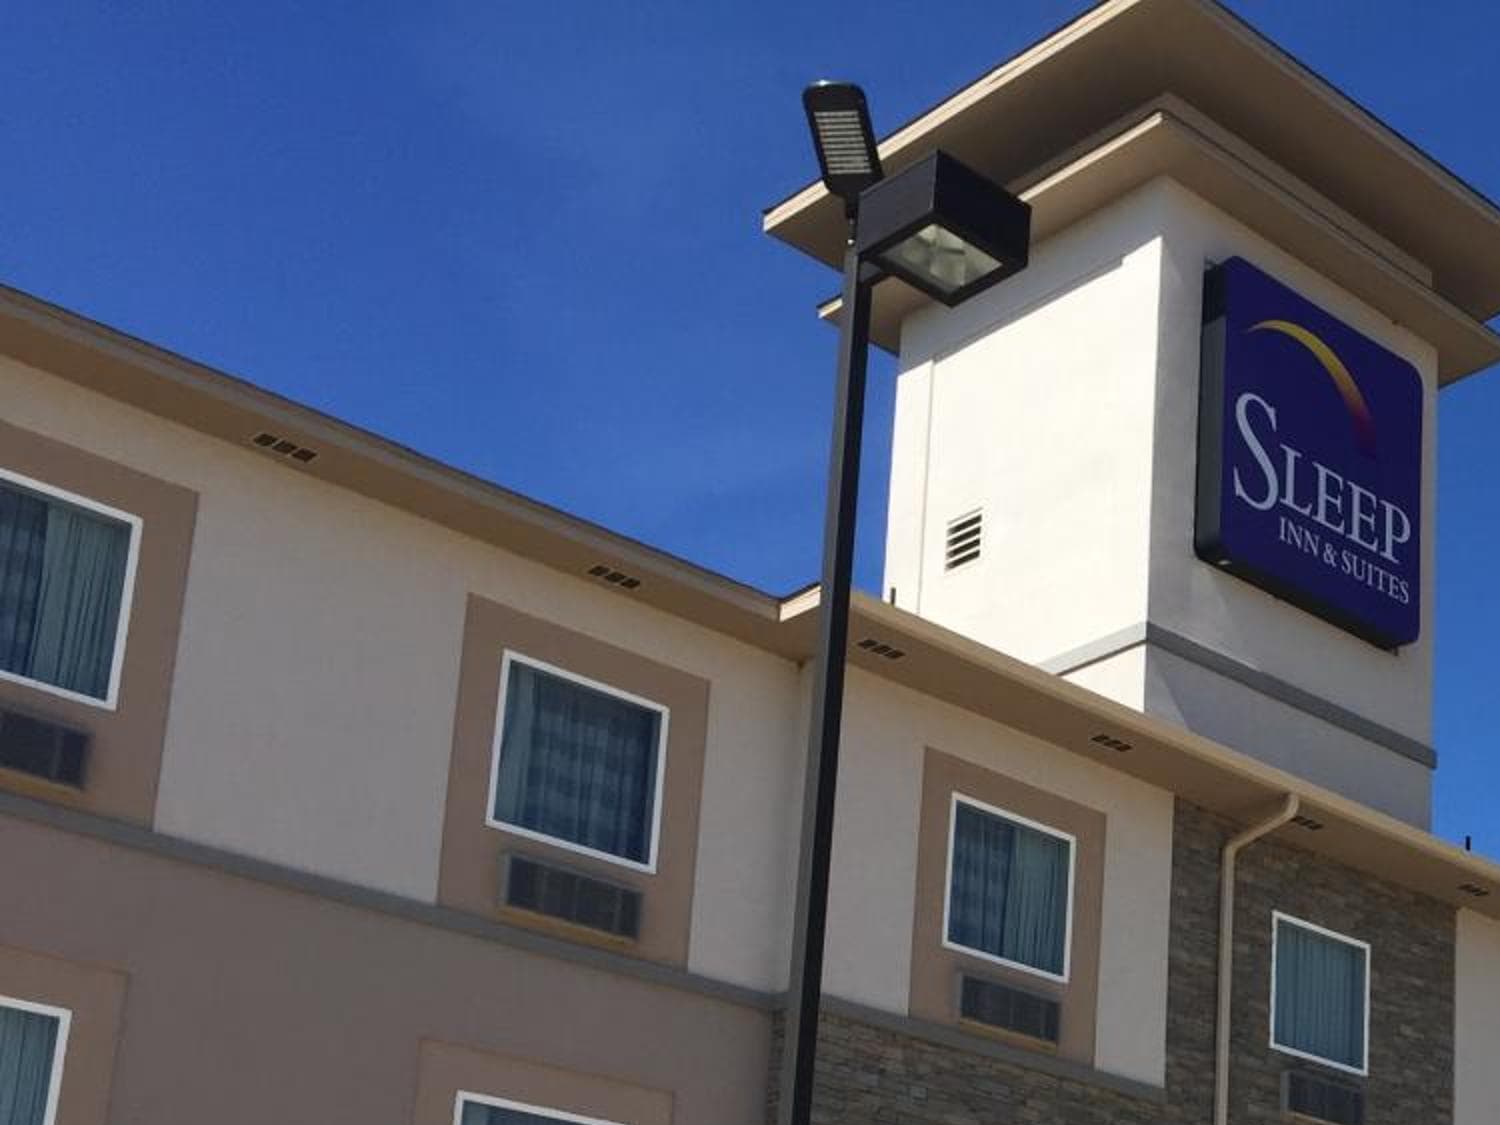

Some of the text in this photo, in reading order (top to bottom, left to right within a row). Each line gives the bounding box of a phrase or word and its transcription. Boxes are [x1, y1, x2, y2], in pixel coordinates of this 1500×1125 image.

[1234, 393, 1411, 564] SLEEP
[1279, 516, 1409, 604] INN & SUITES
